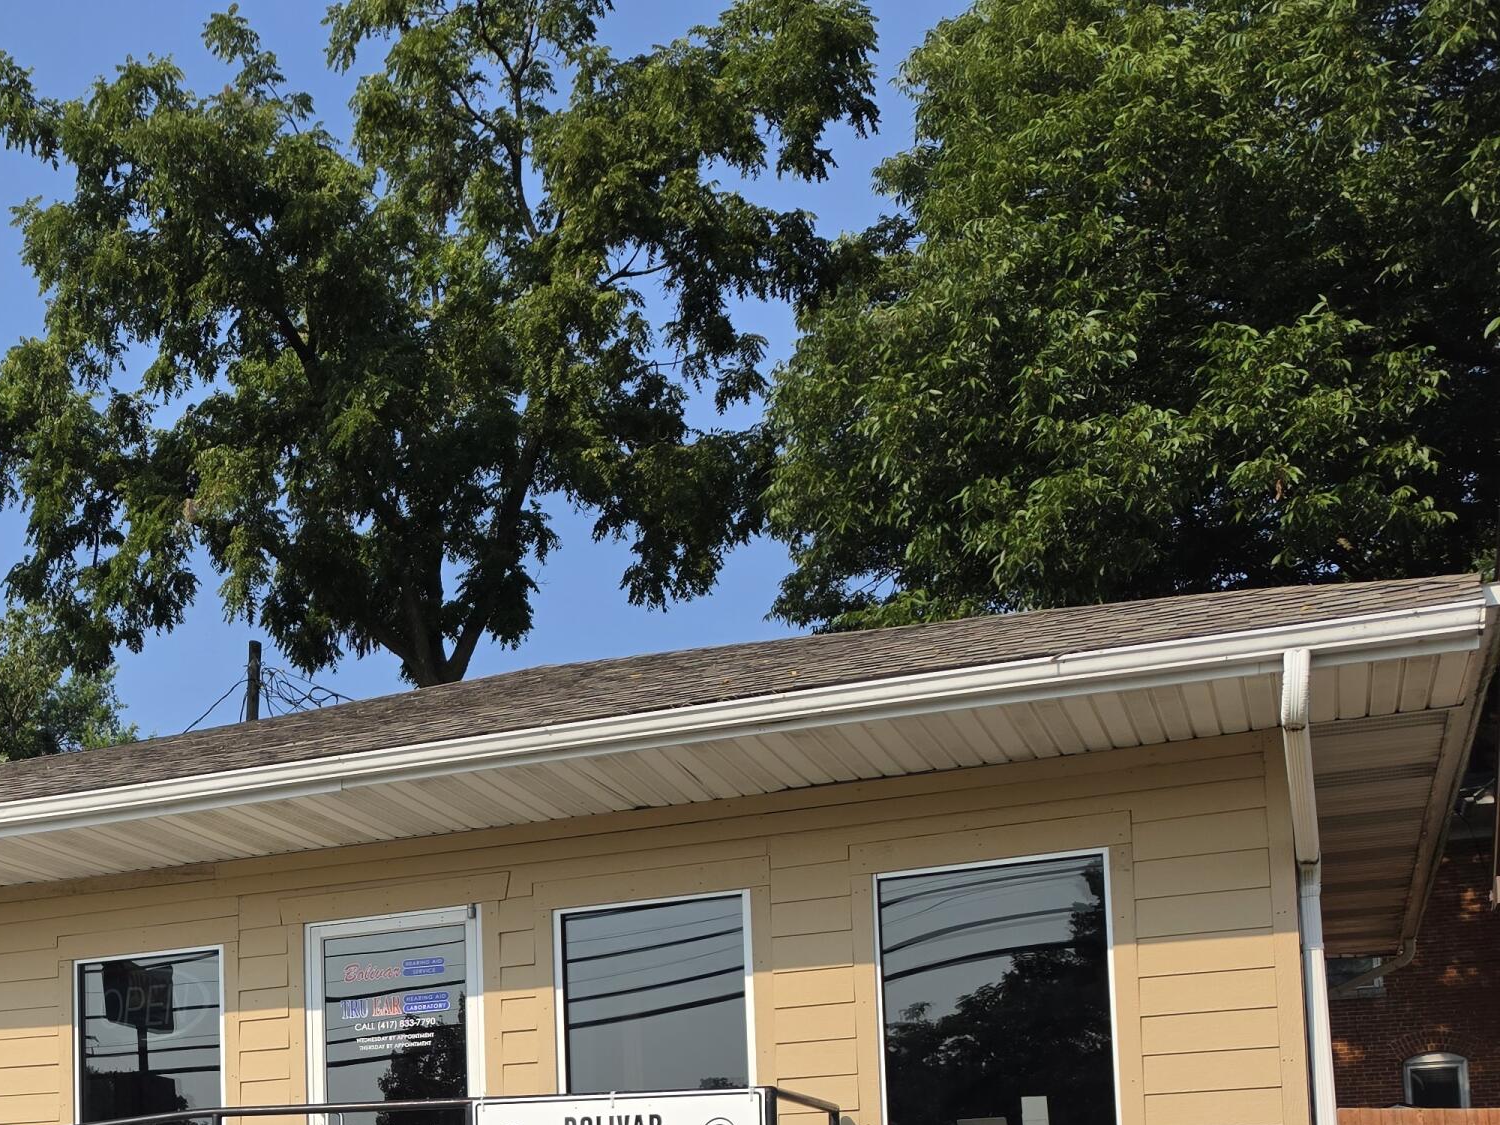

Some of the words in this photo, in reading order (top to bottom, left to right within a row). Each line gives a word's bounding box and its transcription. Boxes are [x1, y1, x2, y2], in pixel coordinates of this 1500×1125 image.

[340, 999, 369, 1019] TRU
[372, 995, 403, 1017] EAR
[406, 1002, 448, 1012] LABORATORY
[354, 1023, 376, 1031] CALL
[377, 1020, 397, 1031] (417)
